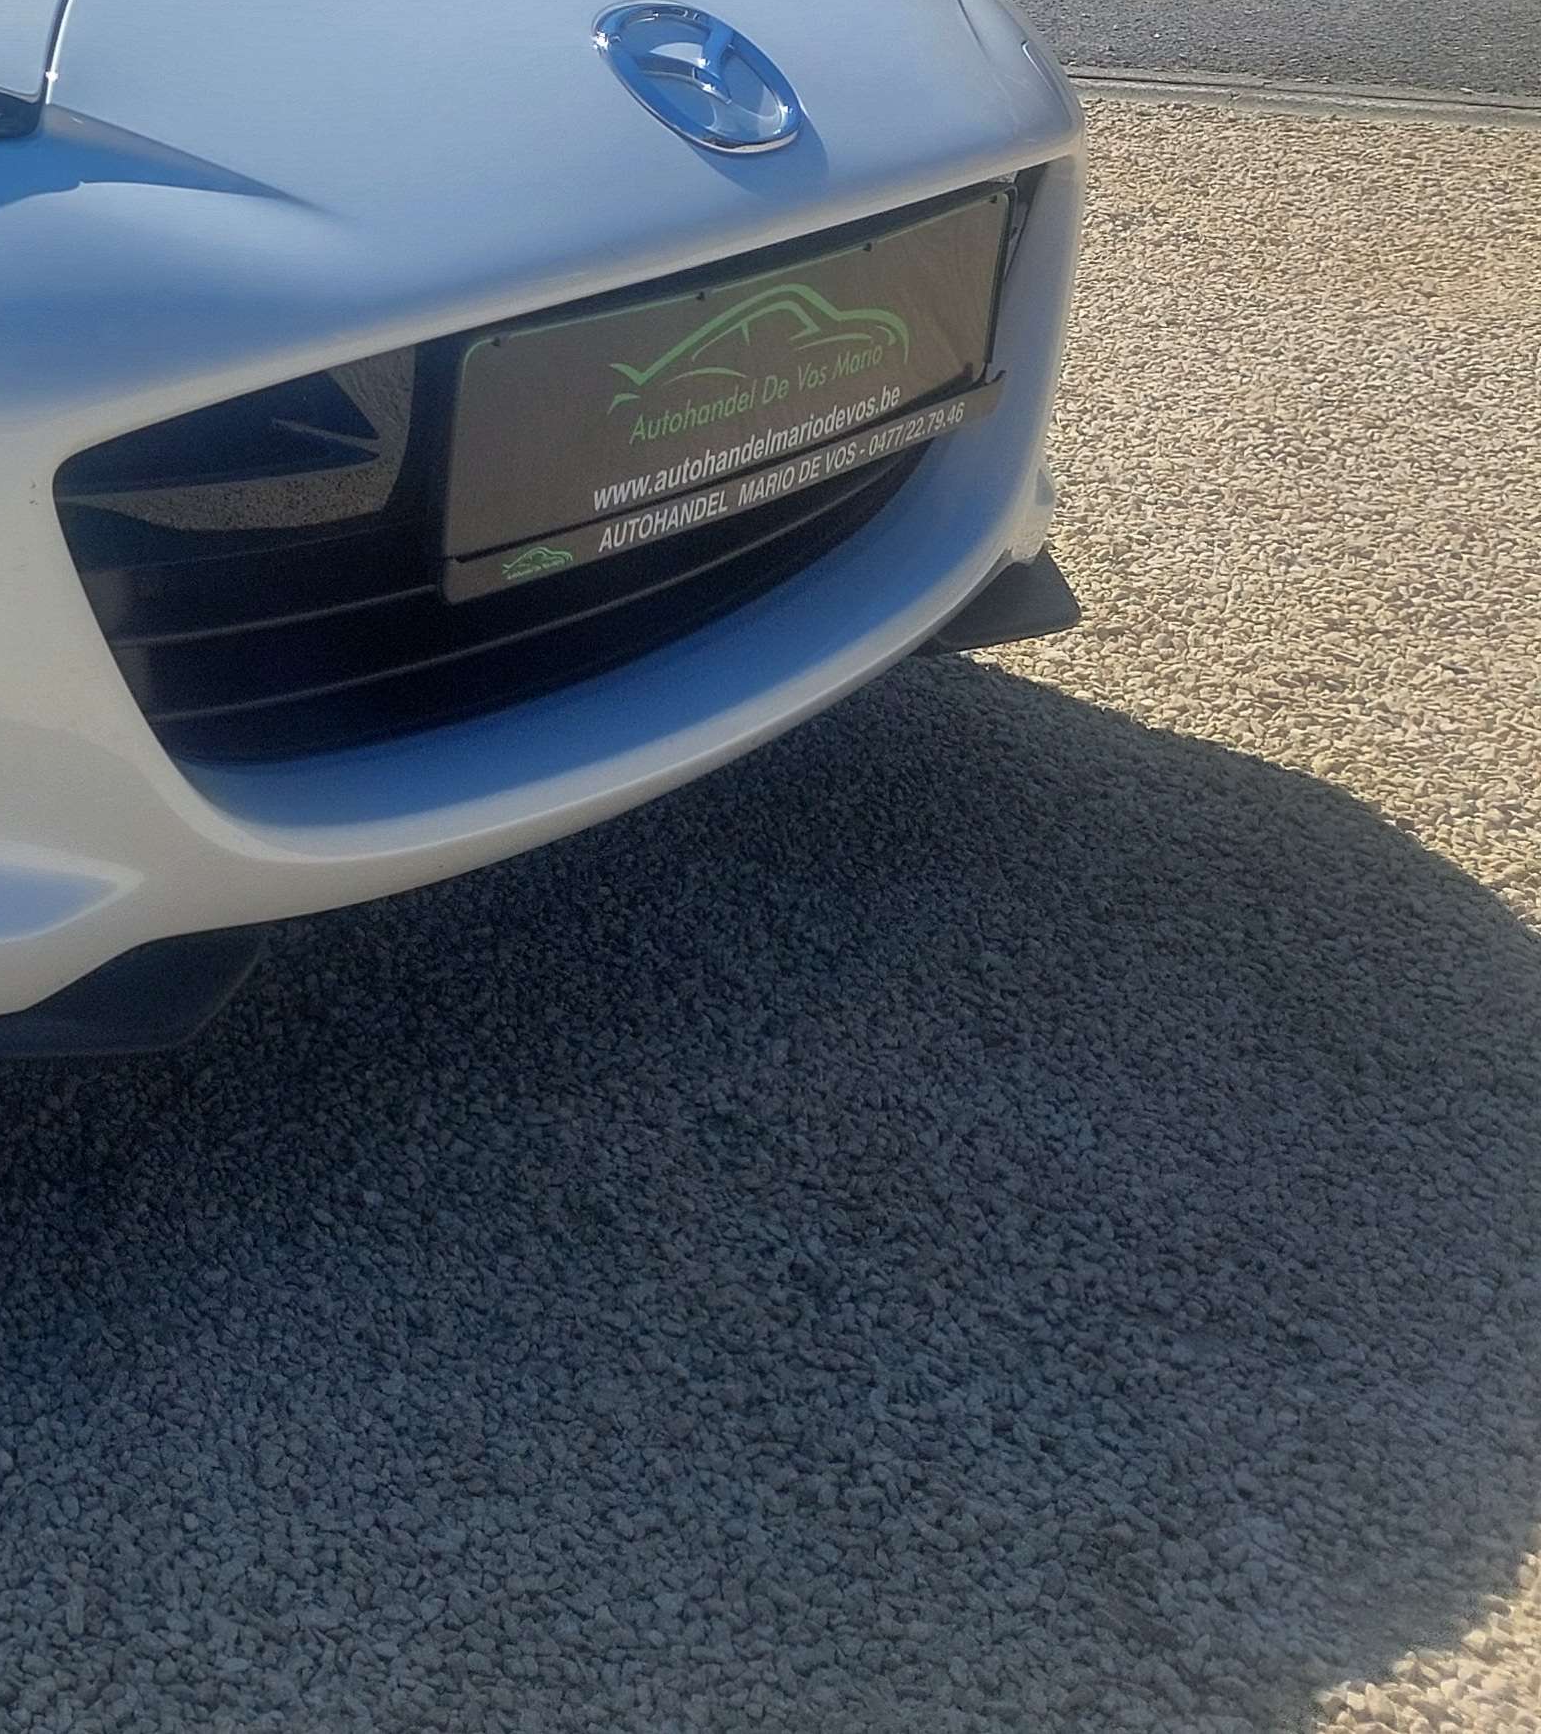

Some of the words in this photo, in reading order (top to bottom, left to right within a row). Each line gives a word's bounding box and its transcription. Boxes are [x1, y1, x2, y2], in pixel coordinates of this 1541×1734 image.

[593, 384, 901, 512] www.autohandelmariodevos.be
[629, 379, 757, 445] Autohandel
[761, 374, 790, 405] De
[797, 360, 827, 392] Vos
[830, 343, 884, 381] Mario
[598, 489, 728, 553] AUTOHANDEL
[738, 465, 795, 507] MARIO
[798, 455, 822, 484] DE
[824, 441, 857, 473] VOS
[869, 401, 965, 456] 0477/22.79.46
